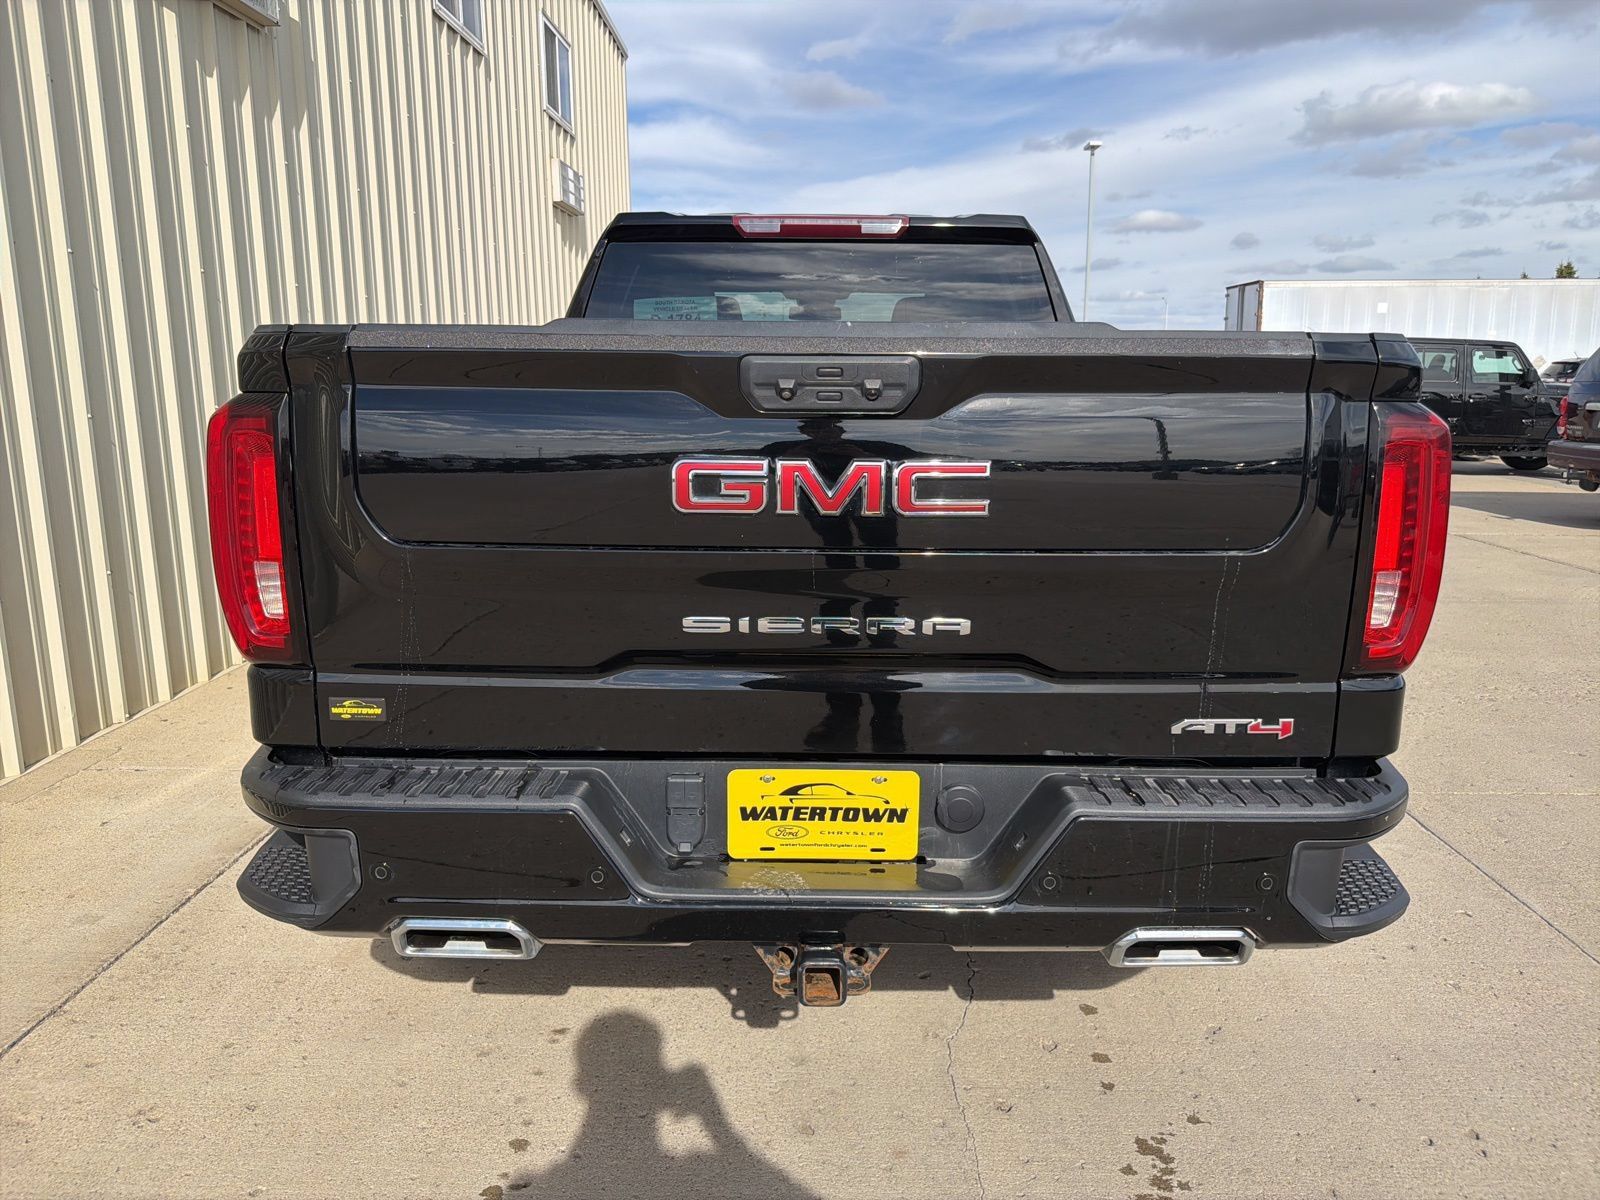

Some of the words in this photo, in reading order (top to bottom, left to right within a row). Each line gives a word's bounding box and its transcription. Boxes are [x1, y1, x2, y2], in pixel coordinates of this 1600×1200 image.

[671, 457, 992, 517] GMC
[682, 616, 972, 636] SIERRA
[331, 707, 382, 715] WATERTOWN
[1170, 718, 1294, 740] AT4
[739, 806, 909, 823] WATERTOWN
[773, 825, 801, 838] Ford
